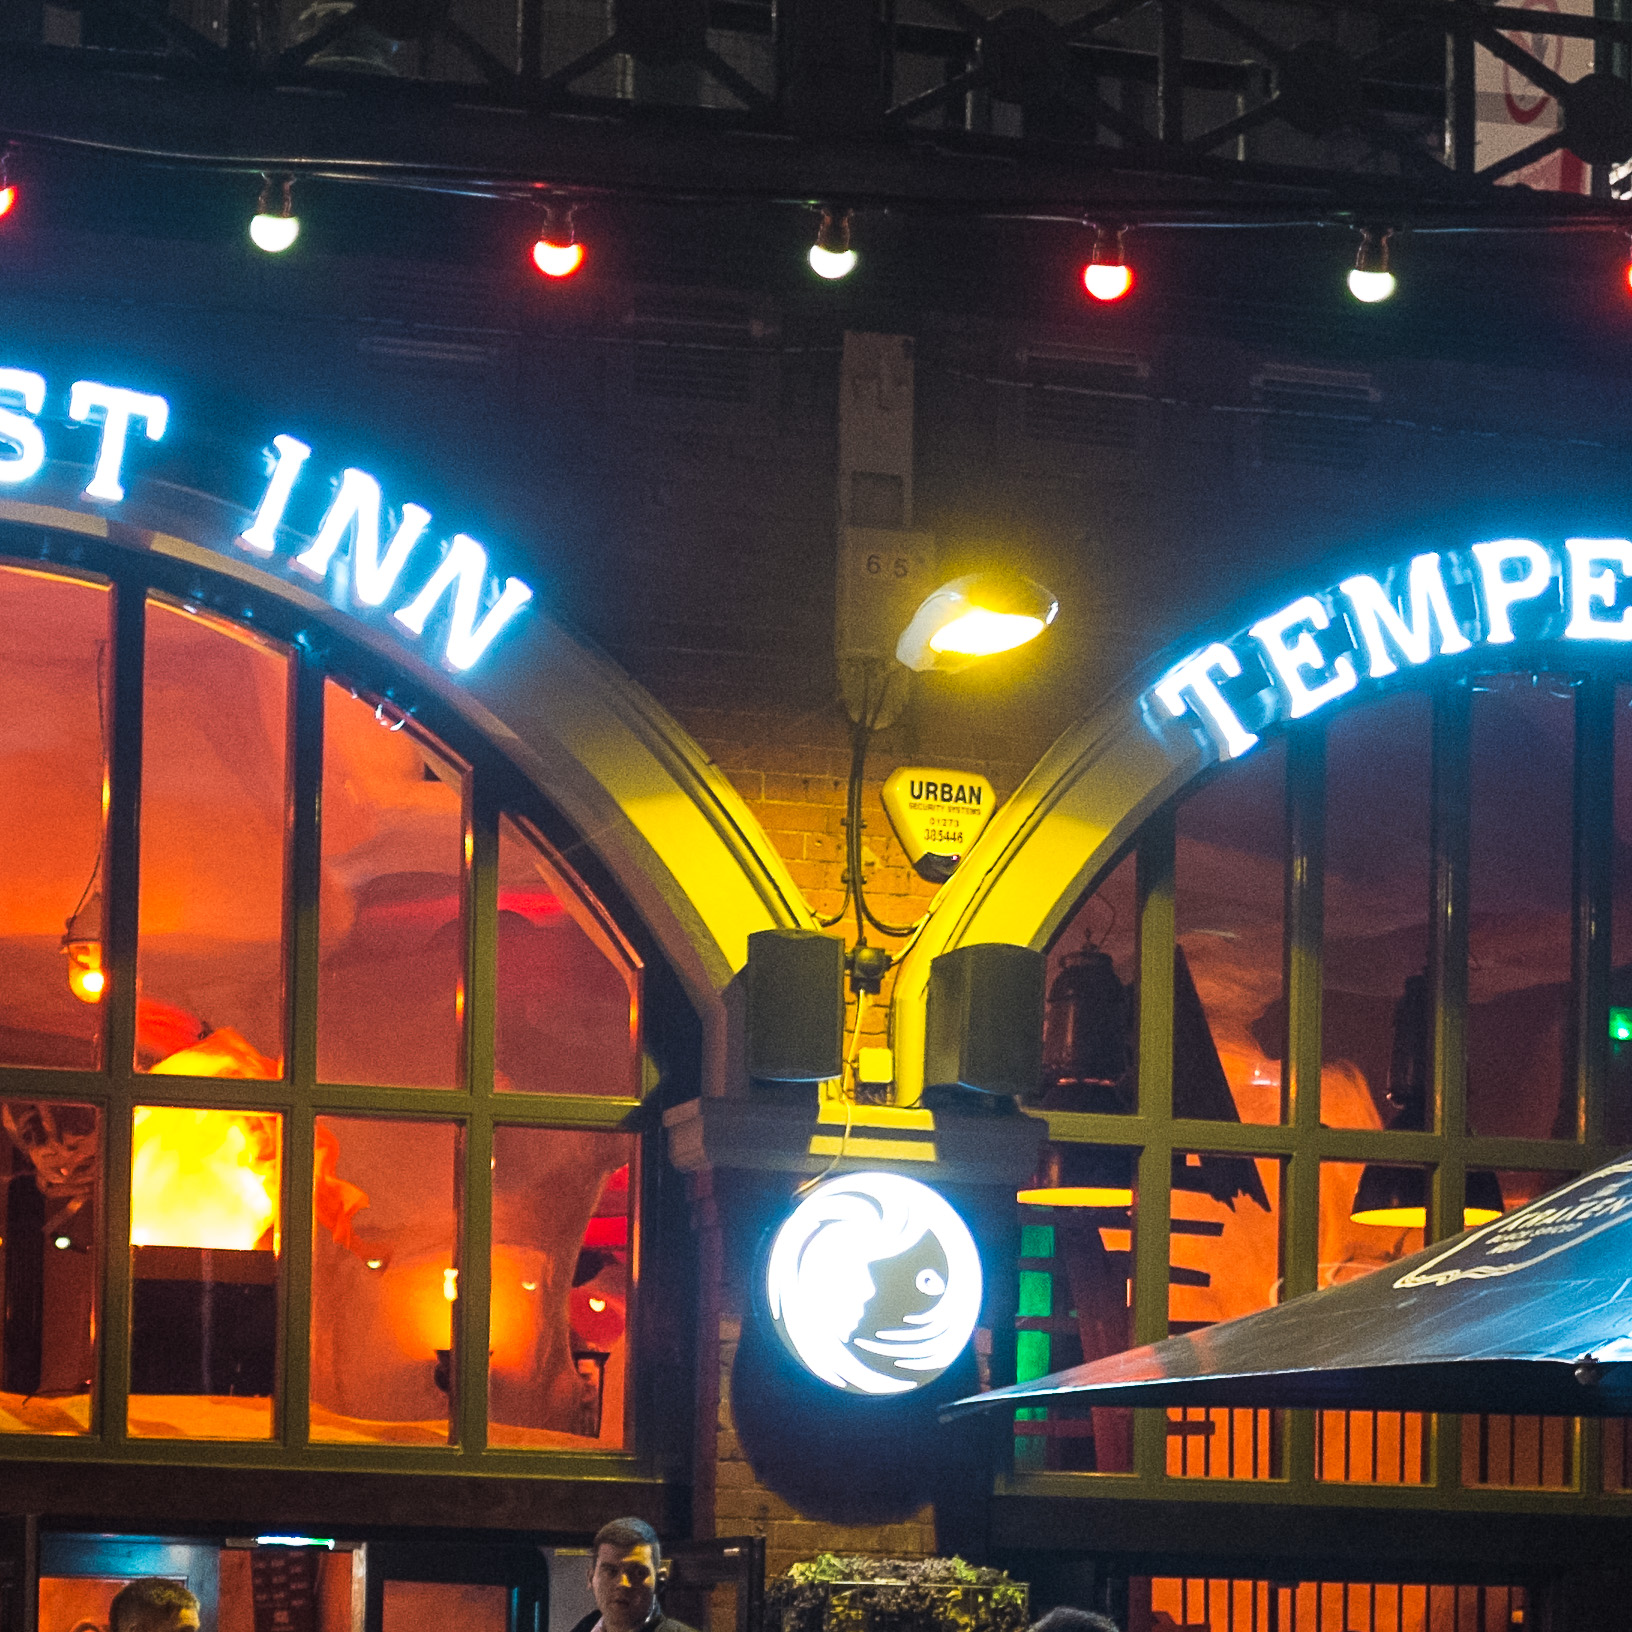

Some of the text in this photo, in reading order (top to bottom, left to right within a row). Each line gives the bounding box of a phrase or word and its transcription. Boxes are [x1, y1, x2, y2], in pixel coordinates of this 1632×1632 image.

[235, 434, 533, 673] INN
[910, 780, 981, 805] URBAN
[909, 802, 981, 815] SECURITY SYSTEMS
[929, 817, 959, 827] 01273
